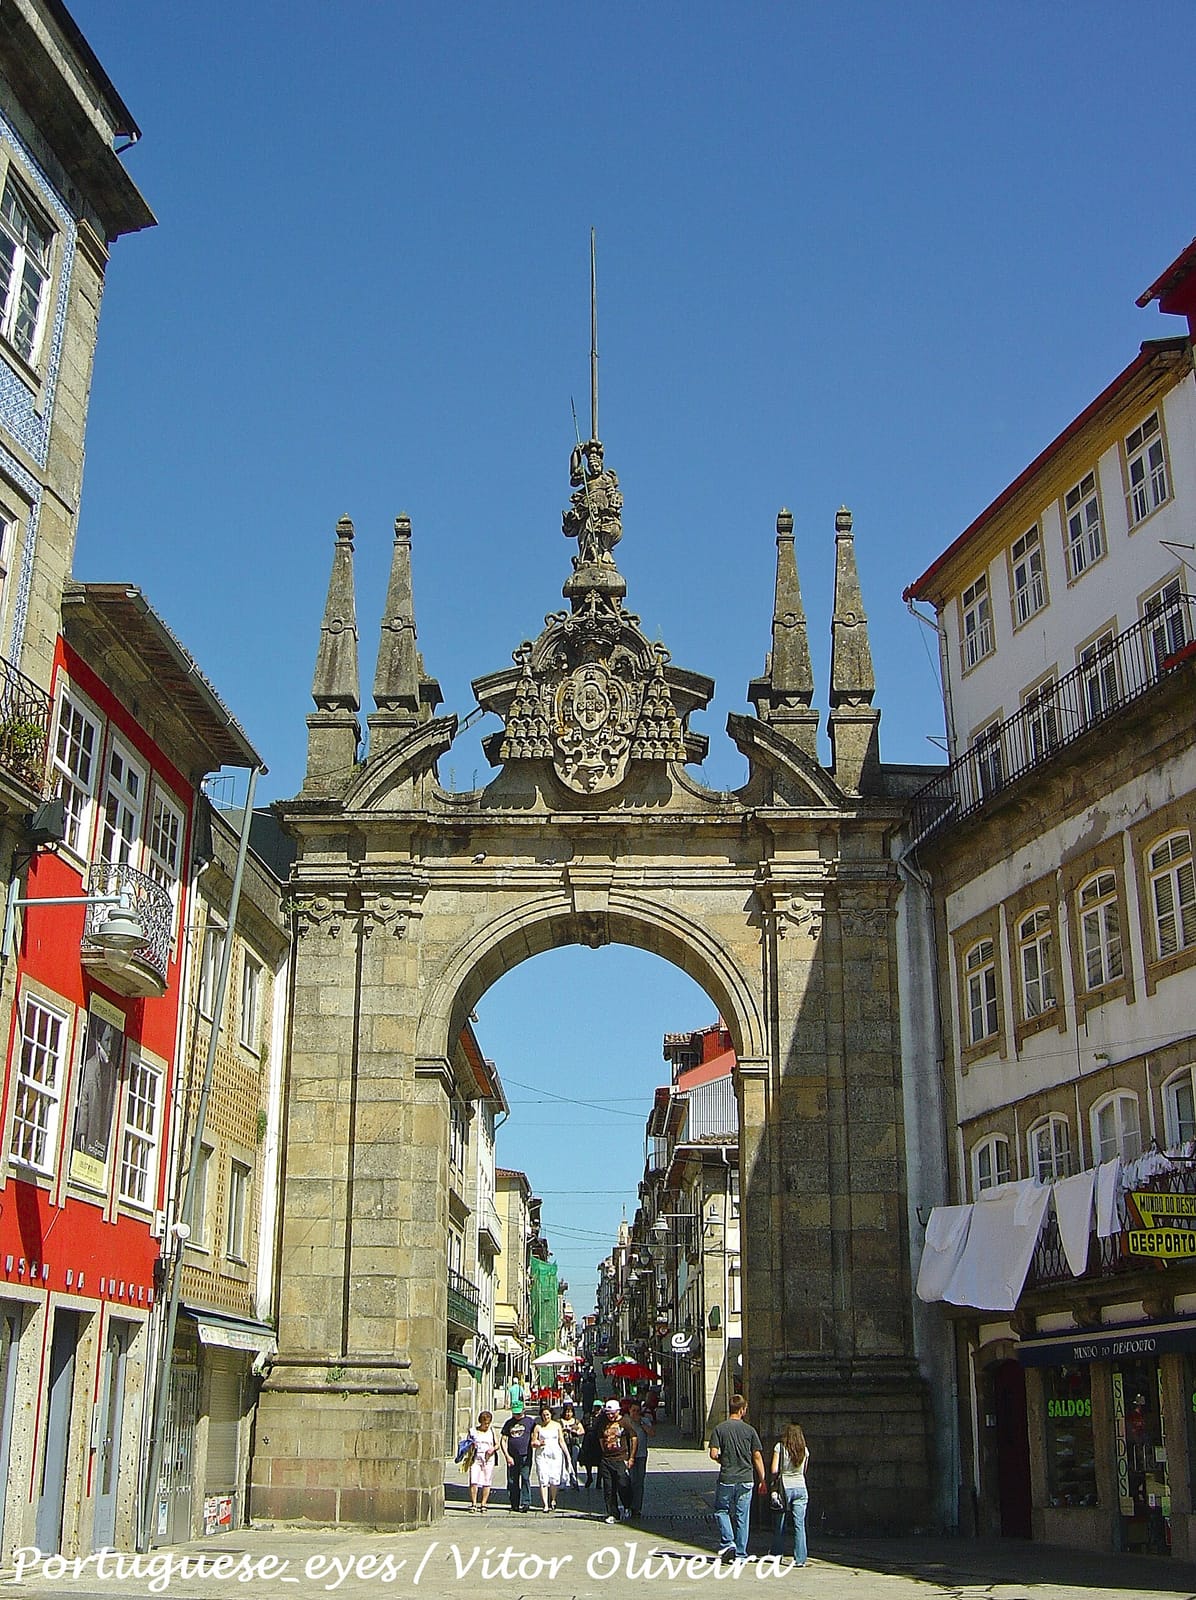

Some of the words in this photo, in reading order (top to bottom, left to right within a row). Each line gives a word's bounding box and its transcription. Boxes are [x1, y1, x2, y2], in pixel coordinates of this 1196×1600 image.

[1140, 1195, 1164, 1213] MUNDO
[1166, 1196, 1175, 1213] DO
[1131, 1233, 1196, 1253] DESPORTO
[1073, 1345, 1098, 1360] MUNDO
[1112, 1338, 1156, 1355] DESPORTO
[1048, 1399, 1092, 1417] SALDOS
[1115, 1380, 1127, 1497] SALDOS
